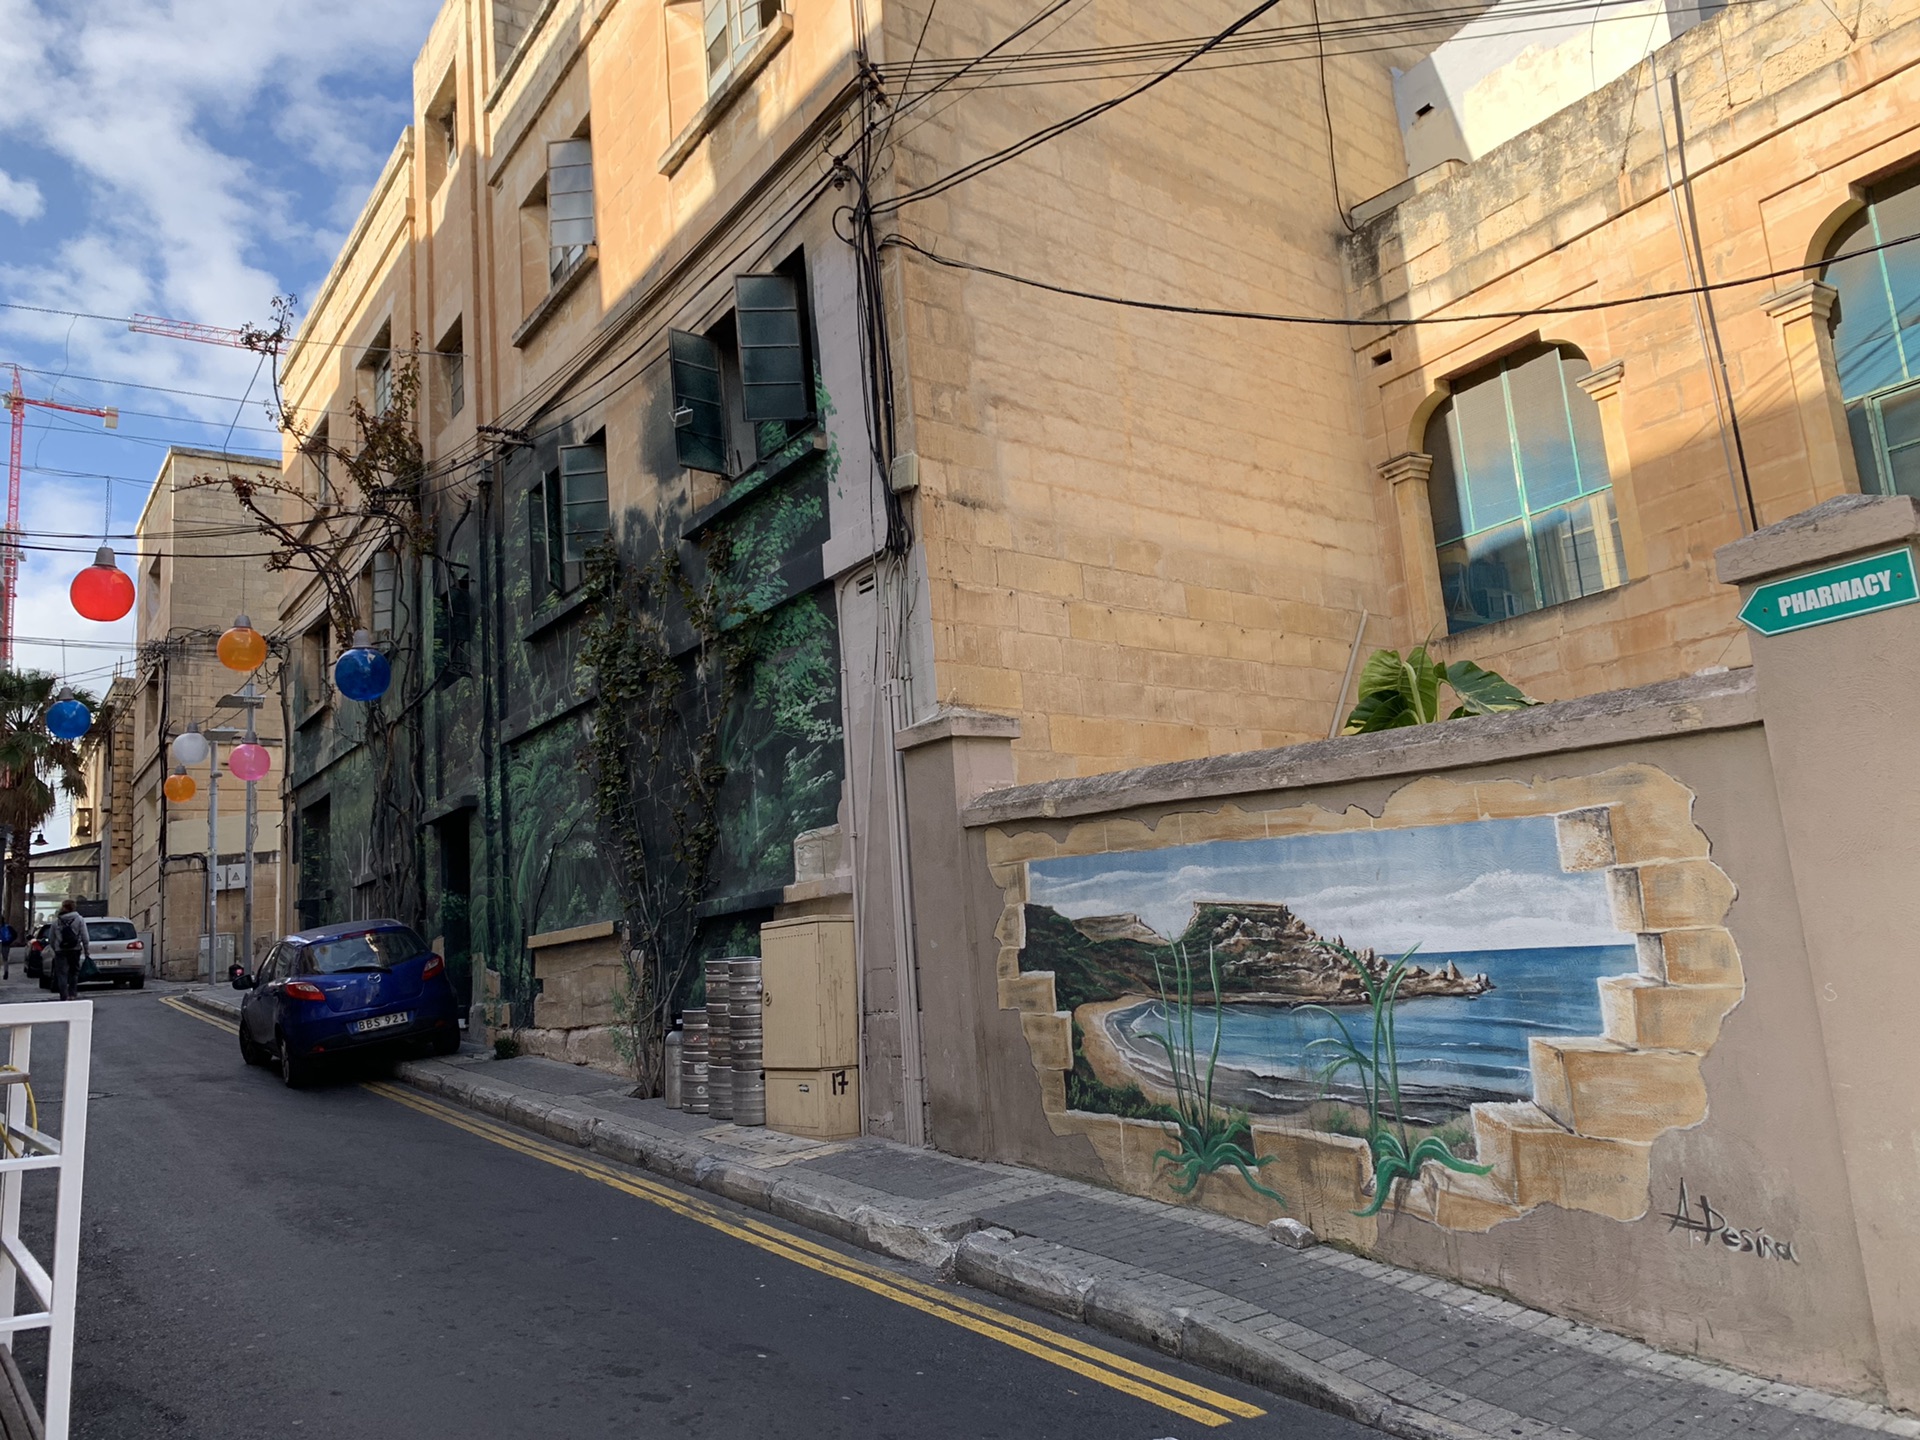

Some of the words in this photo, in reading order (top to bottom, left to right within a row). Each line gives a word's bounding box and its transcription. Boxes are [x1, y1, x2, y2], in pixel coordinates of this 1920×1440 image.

[1777, 570, 1891, 617] PHARMACY
[359, 1017, 381, 1030] BBS
[384, 1013, 406, 1025] 921
[832, 1070, 849, 1096] 17
